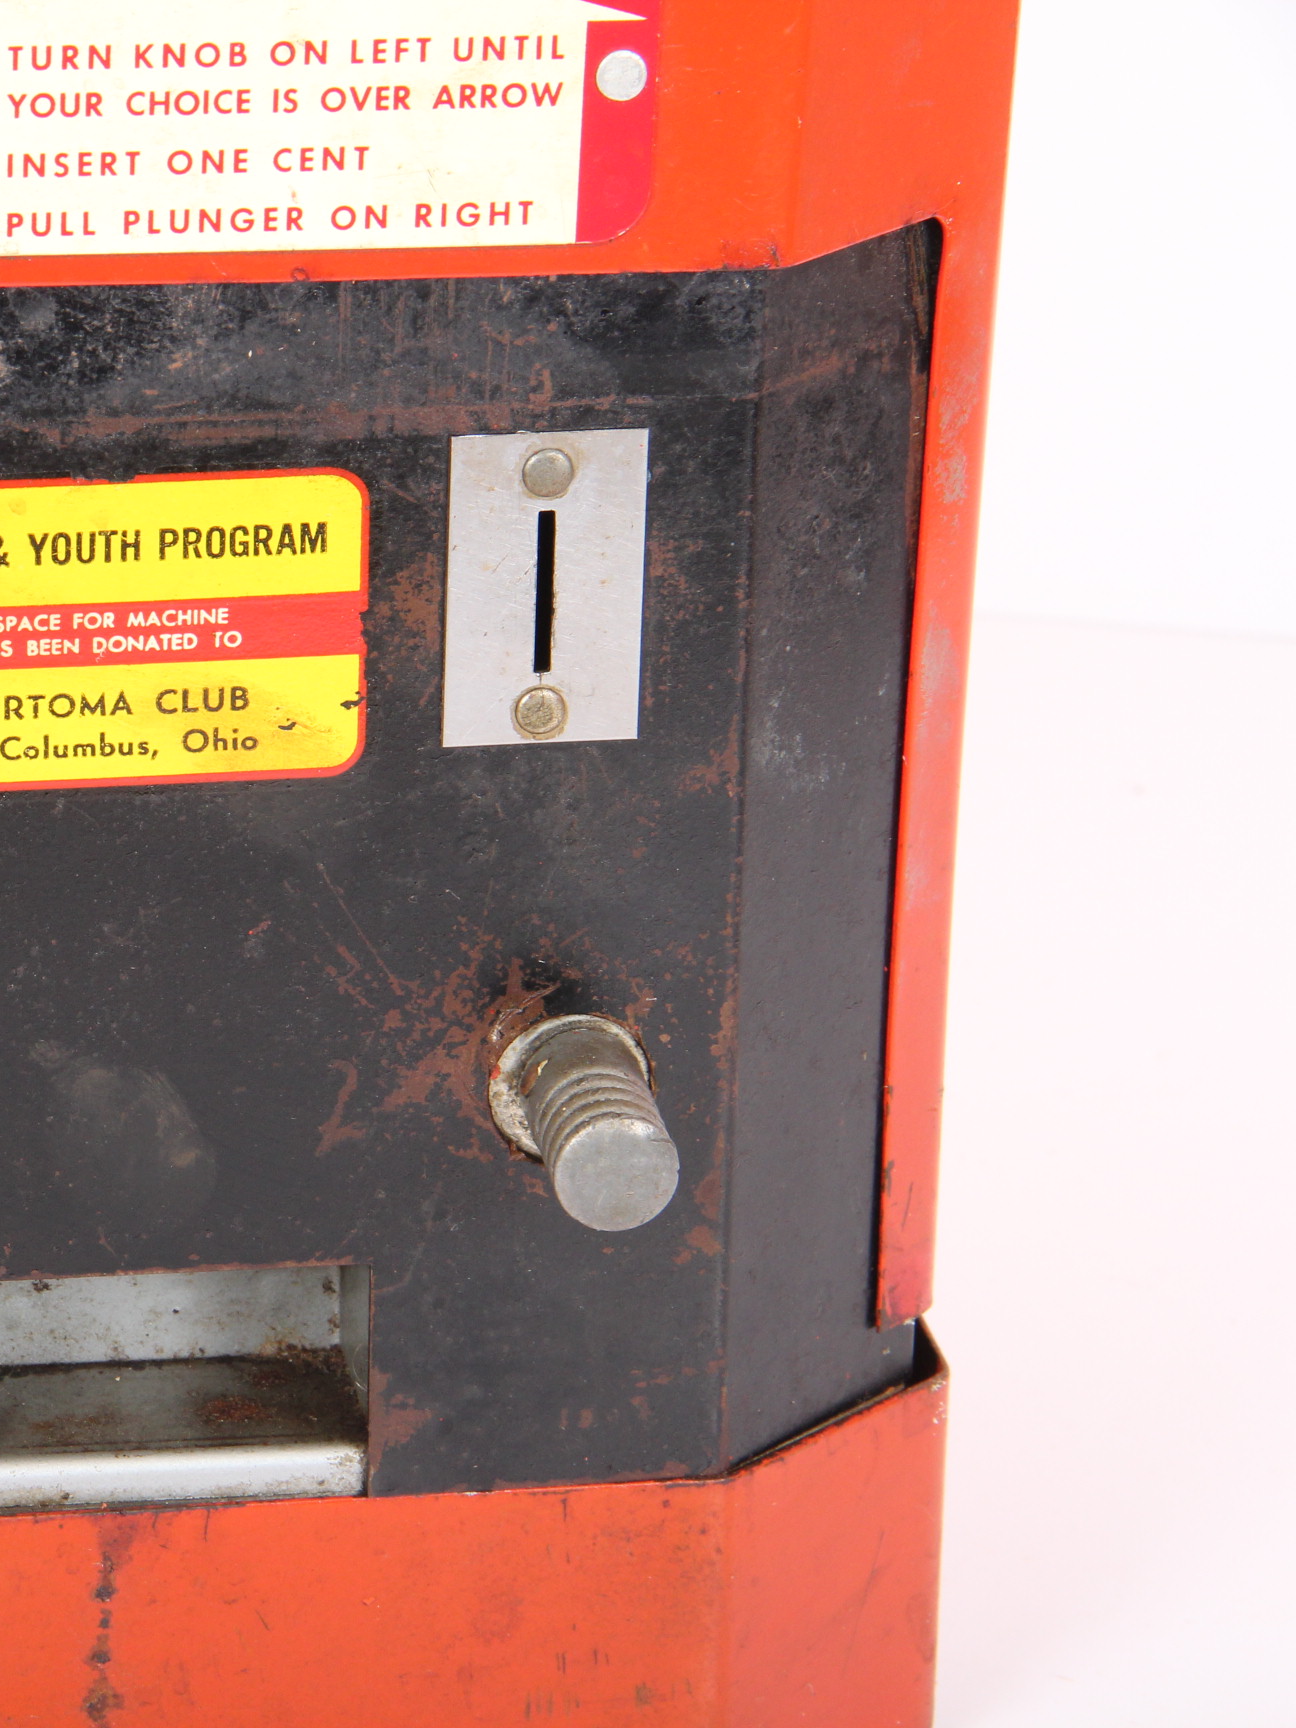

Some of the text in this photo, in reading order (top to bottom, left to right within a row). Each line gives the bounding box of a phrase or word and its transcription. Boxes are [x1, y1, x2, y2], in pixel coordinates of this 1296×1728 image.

[9, 46, 111, 70] TURN
[135, 43, 246, 68] KNOB
[271, 41, 327, 66] ON
[351, 38, 430, 63] LEFT
[454, 36, 563, 62] UNTIL
[8, 83, 562, 118] YOUR CHOICE IS OVER ARROW
[8, 152, 140, 177] INSERT
[168, 149, 247, 174] ONE
[274, 147, 368, 172] CENT
[7, 212, 95, 237] PULL
[124, 208, 302, 234] PLUNGER
[331, 205, 387, 230] ON
[415, 201, 532, 227] RIGHT
[29, 531, 140, 565] YOUTH
[160, 523, 326, 559] PROGRAM
[73, 612, 114, 629] FOR
[127, 608, 228, 627] MACHINE
[27, 638, 79, 656] BEEN
[93, 633, 198, 654] DONATED
[214, 631, 242, 647] TO
[156, 687, 247, 714] CLUB
[0, 733, 156, 760] Columbus,
[183, 728, 257, 752] Ohio
